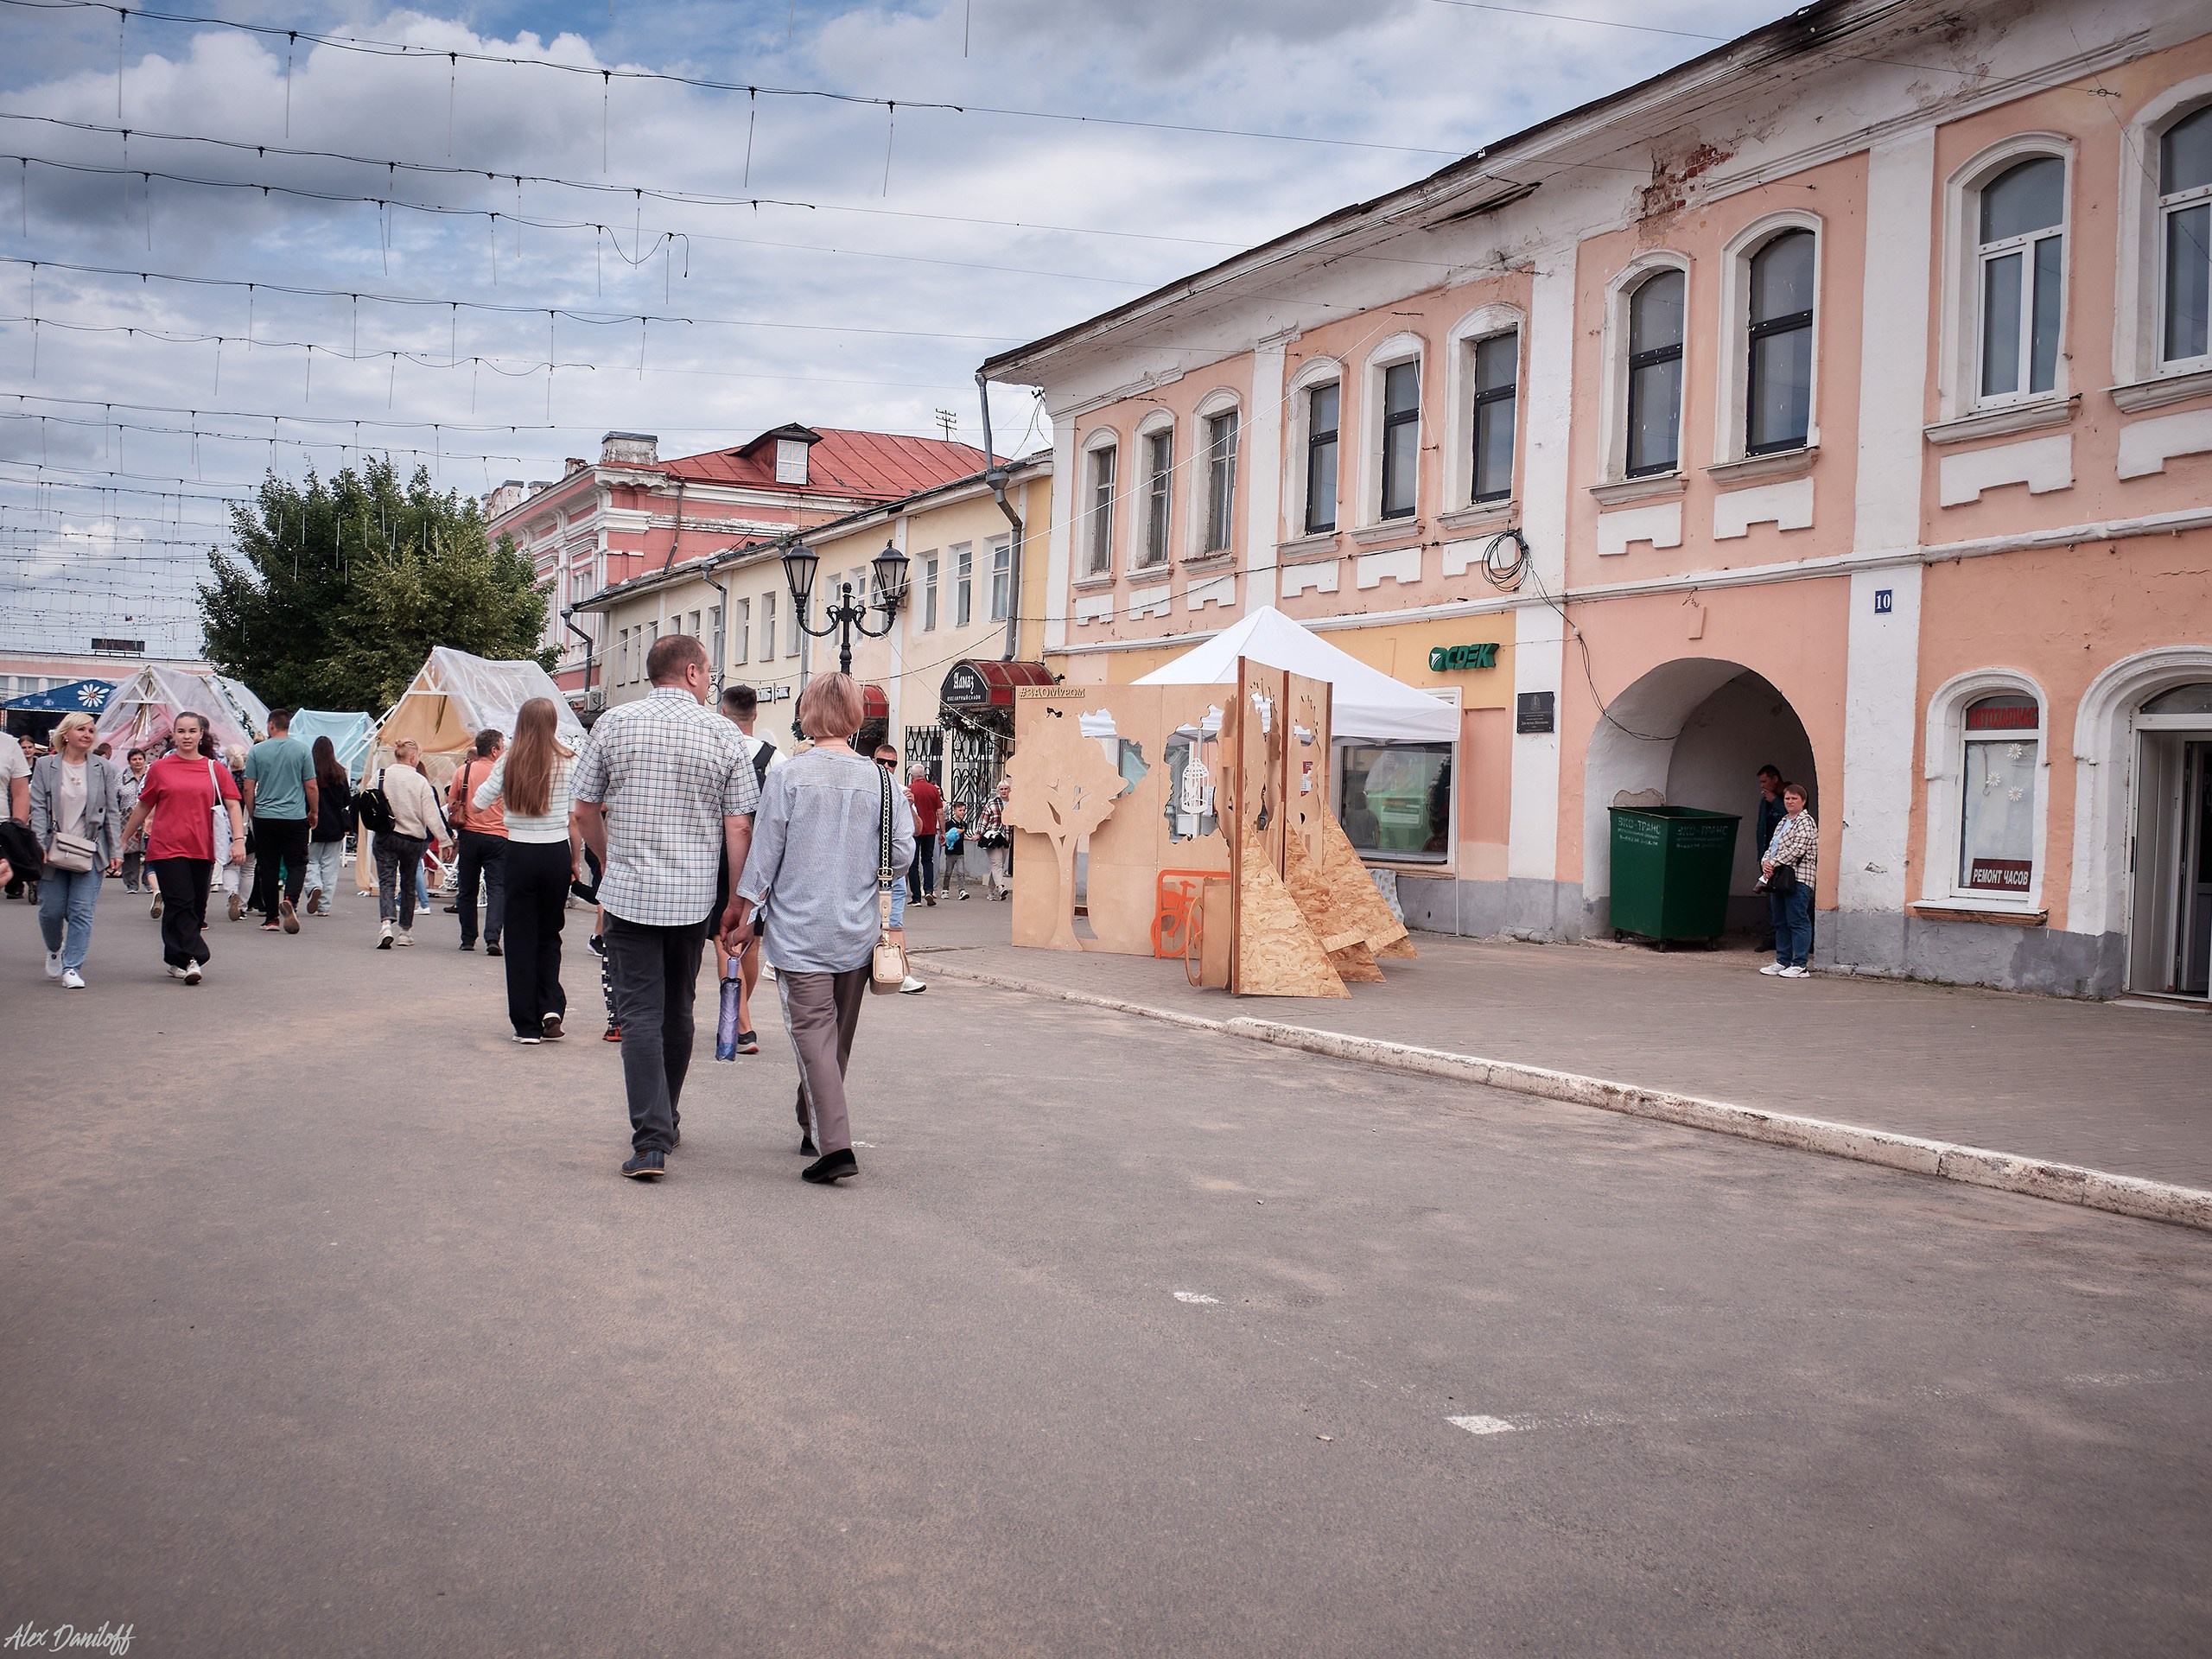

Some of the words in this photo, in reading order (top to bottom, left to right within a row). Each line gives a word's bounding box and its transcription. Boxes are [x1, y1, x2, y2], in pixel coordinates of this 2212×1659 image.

[1876, 594, 1891, 609] 10
[1973, 868, 2003, 884] РЕМОНТ
[2003, 869, 2029, 886] ЧАСОВ
